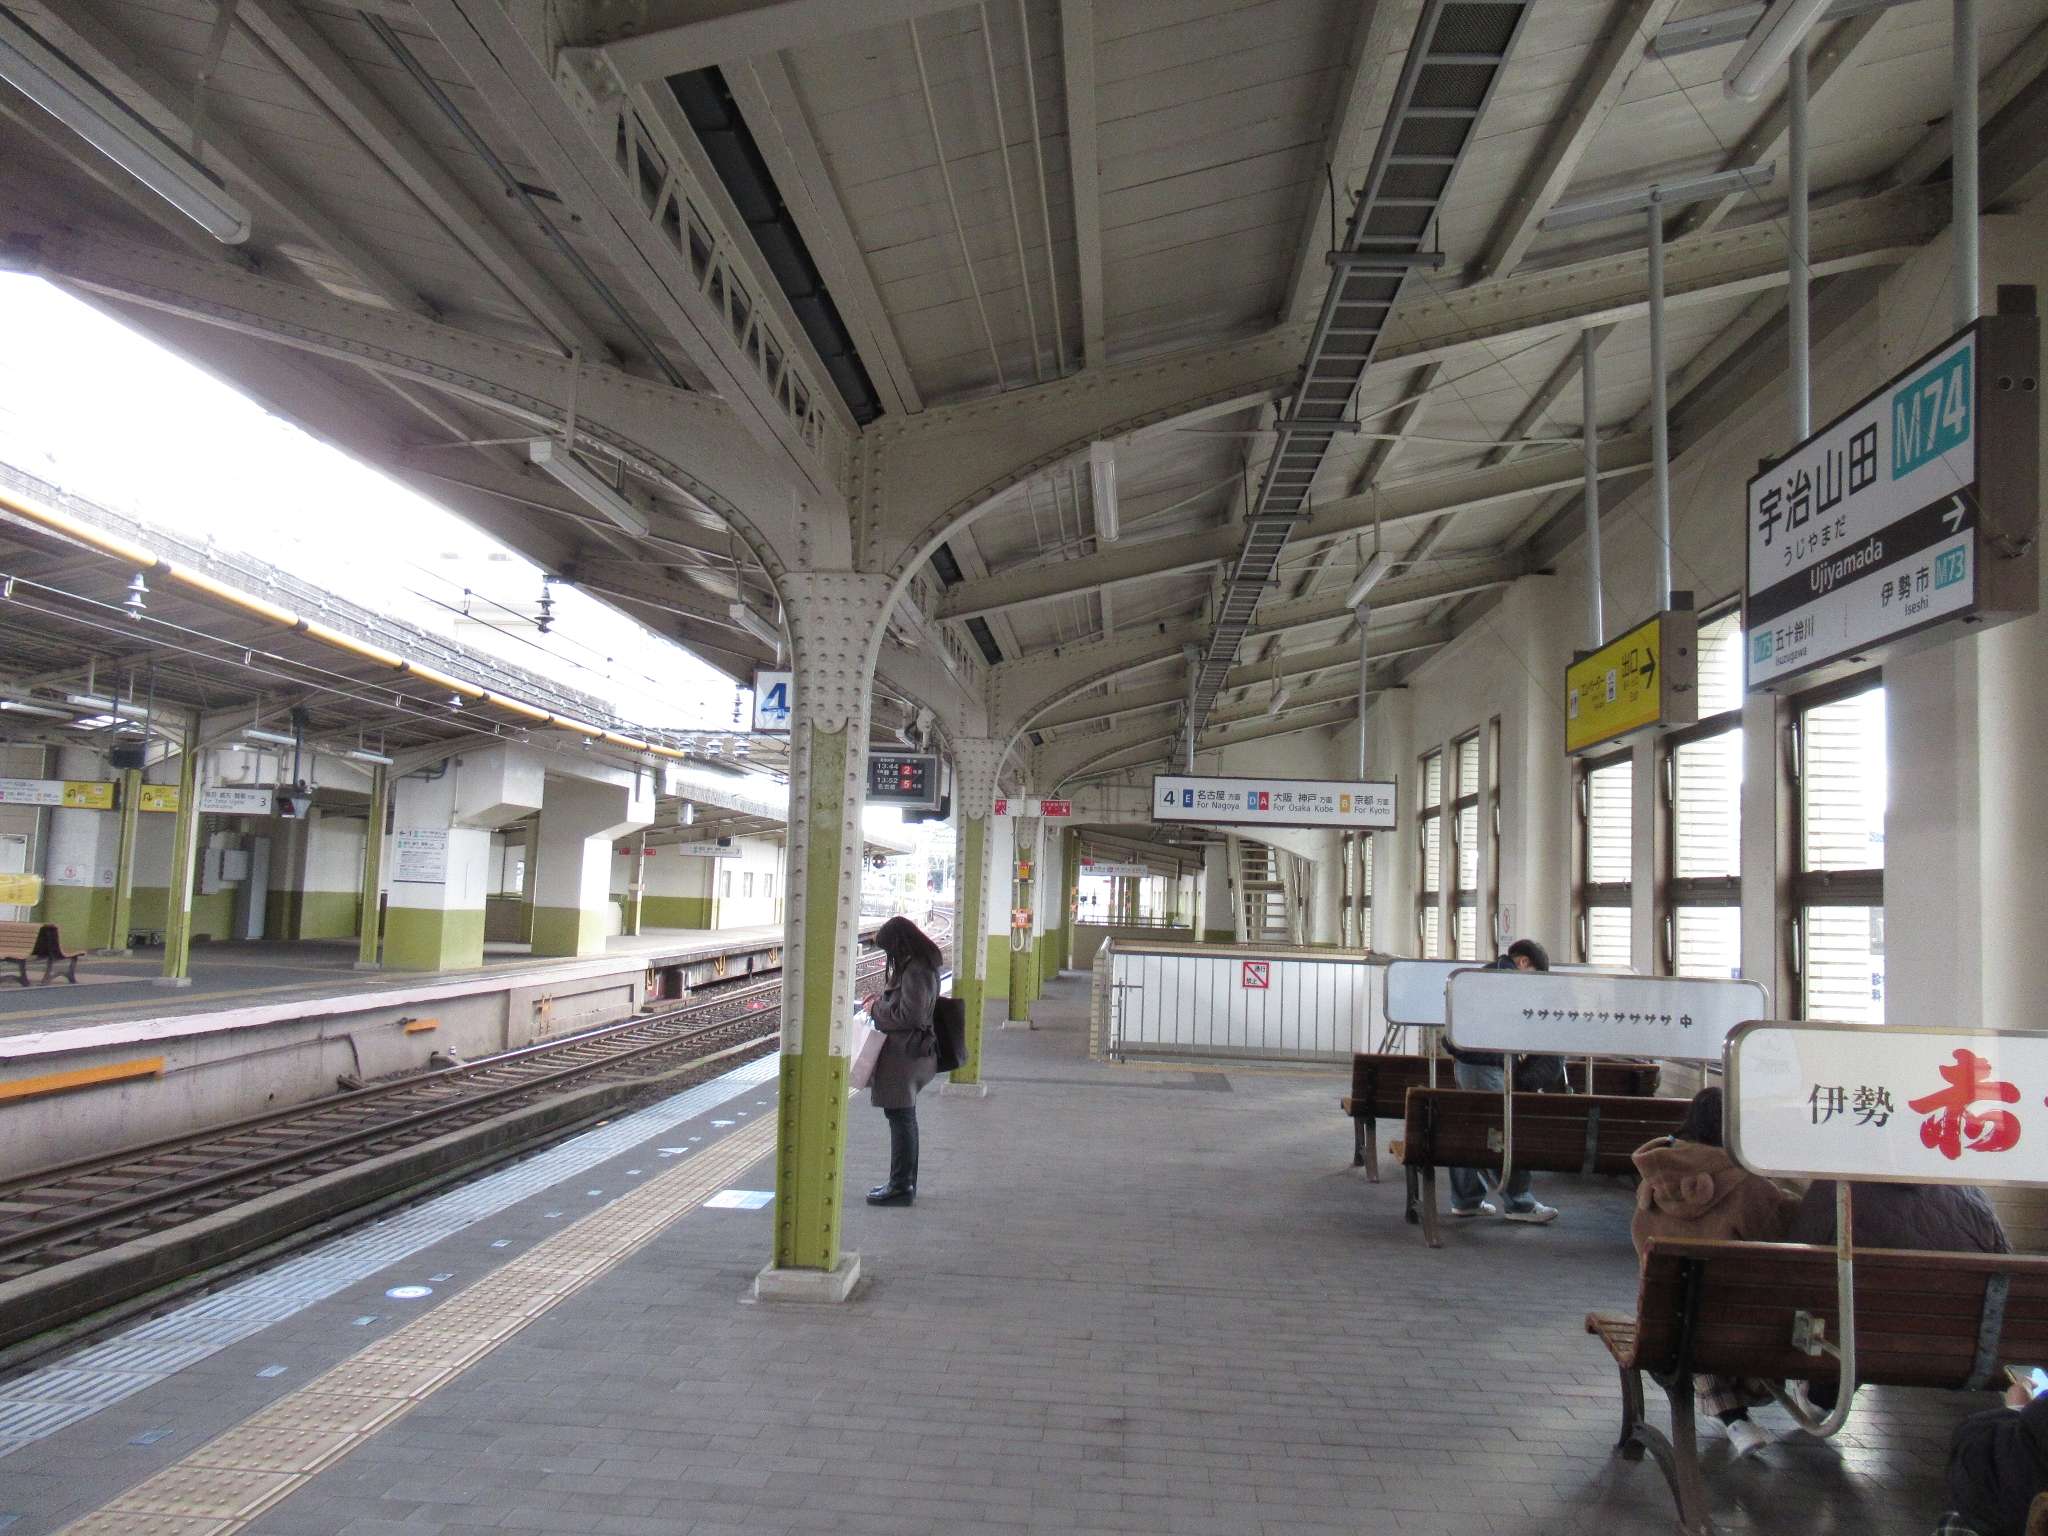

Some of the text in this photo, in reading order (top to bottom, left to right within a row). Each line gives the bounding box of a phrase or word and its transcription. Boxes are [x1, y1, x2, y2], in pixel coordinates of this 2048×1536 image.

[1897, 364, 1966, 468] M74
[1759, 422, 1877, 546] 宇治山田
[1784, 514, 1845, 566] うじやまだ
[1810, 538, 1883, 593] Ujiyamada
[1936, 550, 1964, 587] M73
[1881, 566, 1929, 608] 伊勢市
[1905, 595, 1929, 616] Iseshi
[1776, 615, 1814, 651] 五十鈴川
[761, 682, 790, 720] 4
[259, 797, 266, 807] 3
[1163, 790, 1176, 806] 4
[1196, 800, 1240, 811] For Nagoya
[1197, 789, 1225, 801] 名古屋
[1273, 792, 1293, 802] 大阪
[1298, 793, 1318, 802] 神戸
[1273, 803, 1334, 813] For Osaka Kobe
[1354, 795, 1374, 805] 京都
[1354, 805, 1391, 815] For Kyoto
[1808, 1083, 1894, 1128] 伊勢
